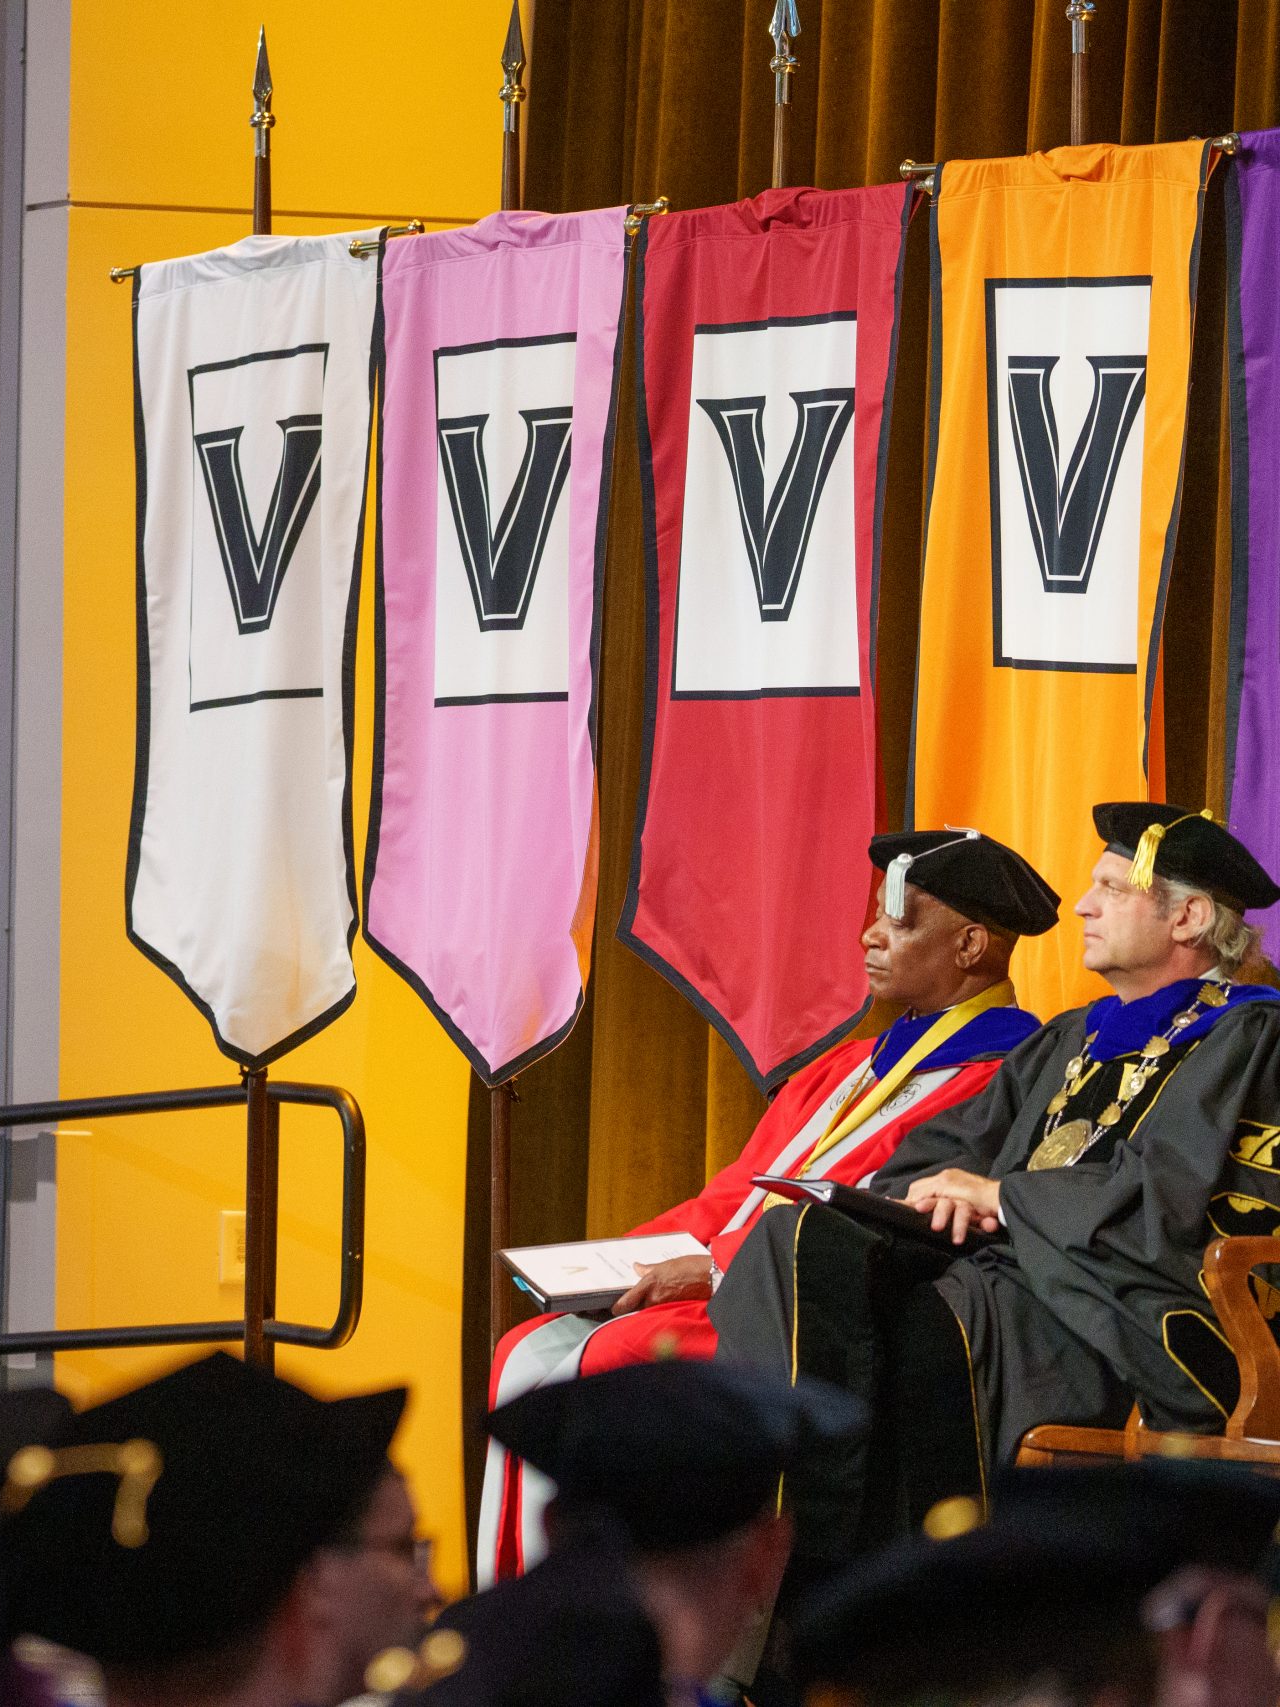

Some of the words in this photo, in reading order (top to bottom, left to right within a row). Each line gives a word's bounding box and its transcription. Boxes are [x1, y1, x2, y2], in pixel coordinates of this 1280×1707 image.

[195, 414, 323, 635] V
[437, 406, 574, 632] V
[696, 387, 856, 622] V
[1008, 355, 1148, 594] V
